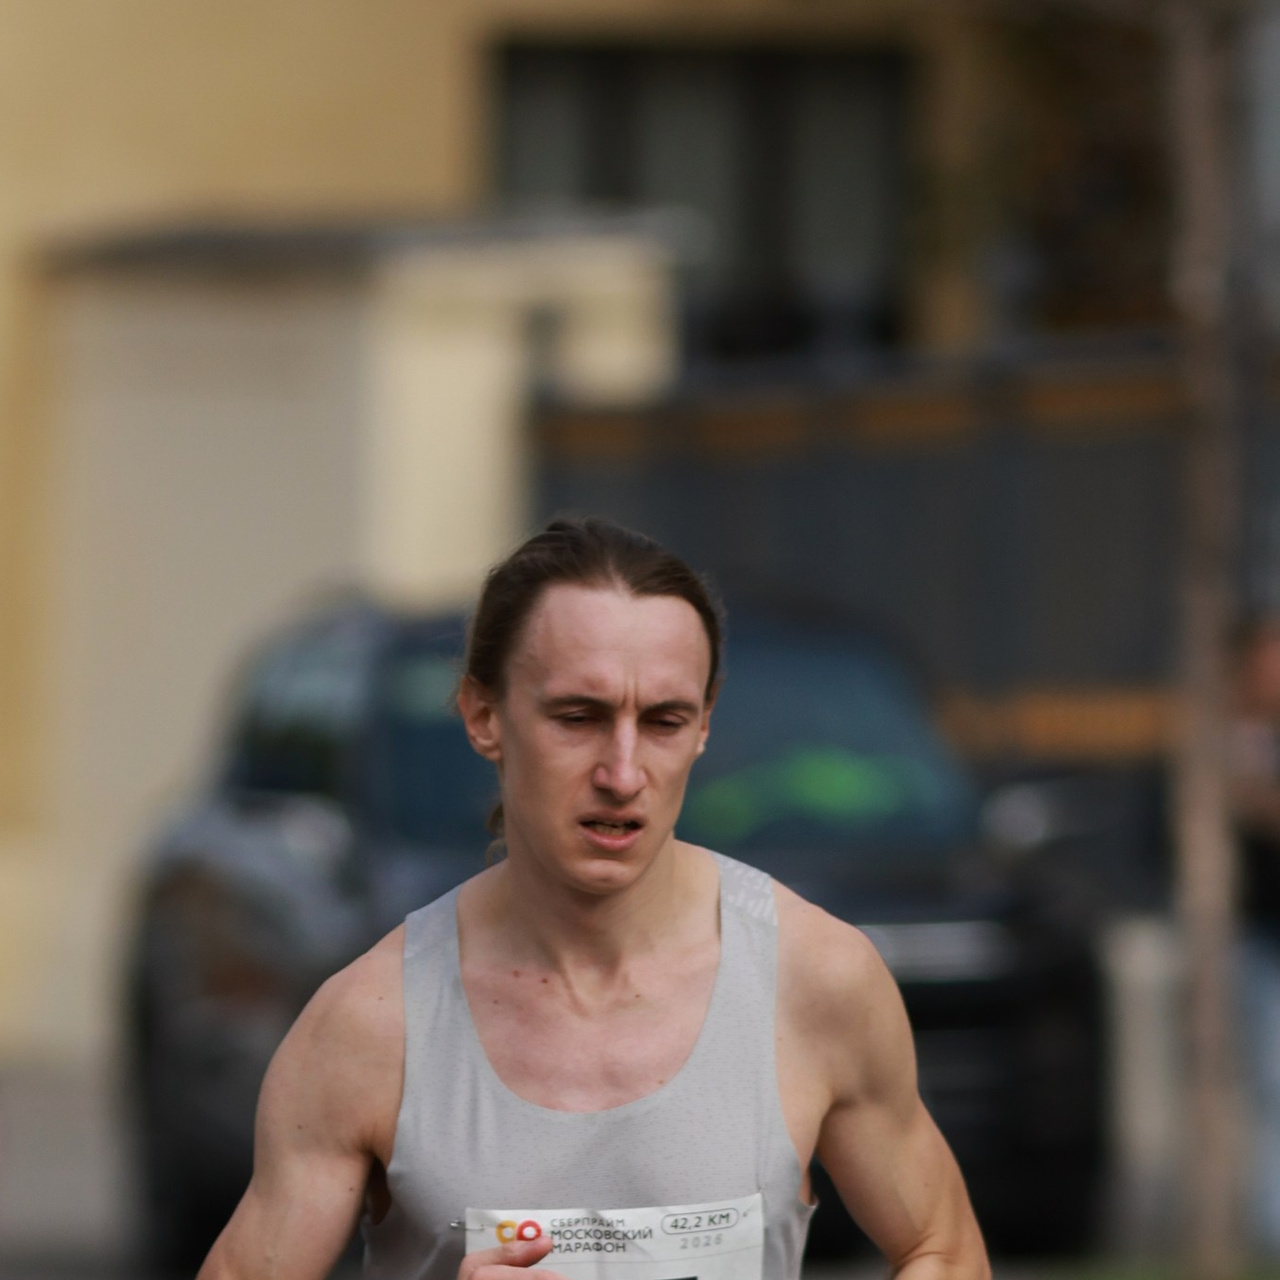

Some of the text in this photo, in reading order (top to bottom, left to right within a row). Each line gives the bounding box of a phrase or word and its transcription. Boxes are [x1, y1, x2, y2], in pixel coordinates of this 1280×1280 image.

[550, 1216, 625, 1228] СБЕРПРАЙМ
[550, 1226, 653, 1241] МОСКОВСКИЙ
[551, 1242, 626, 1254] МАРАФОН
